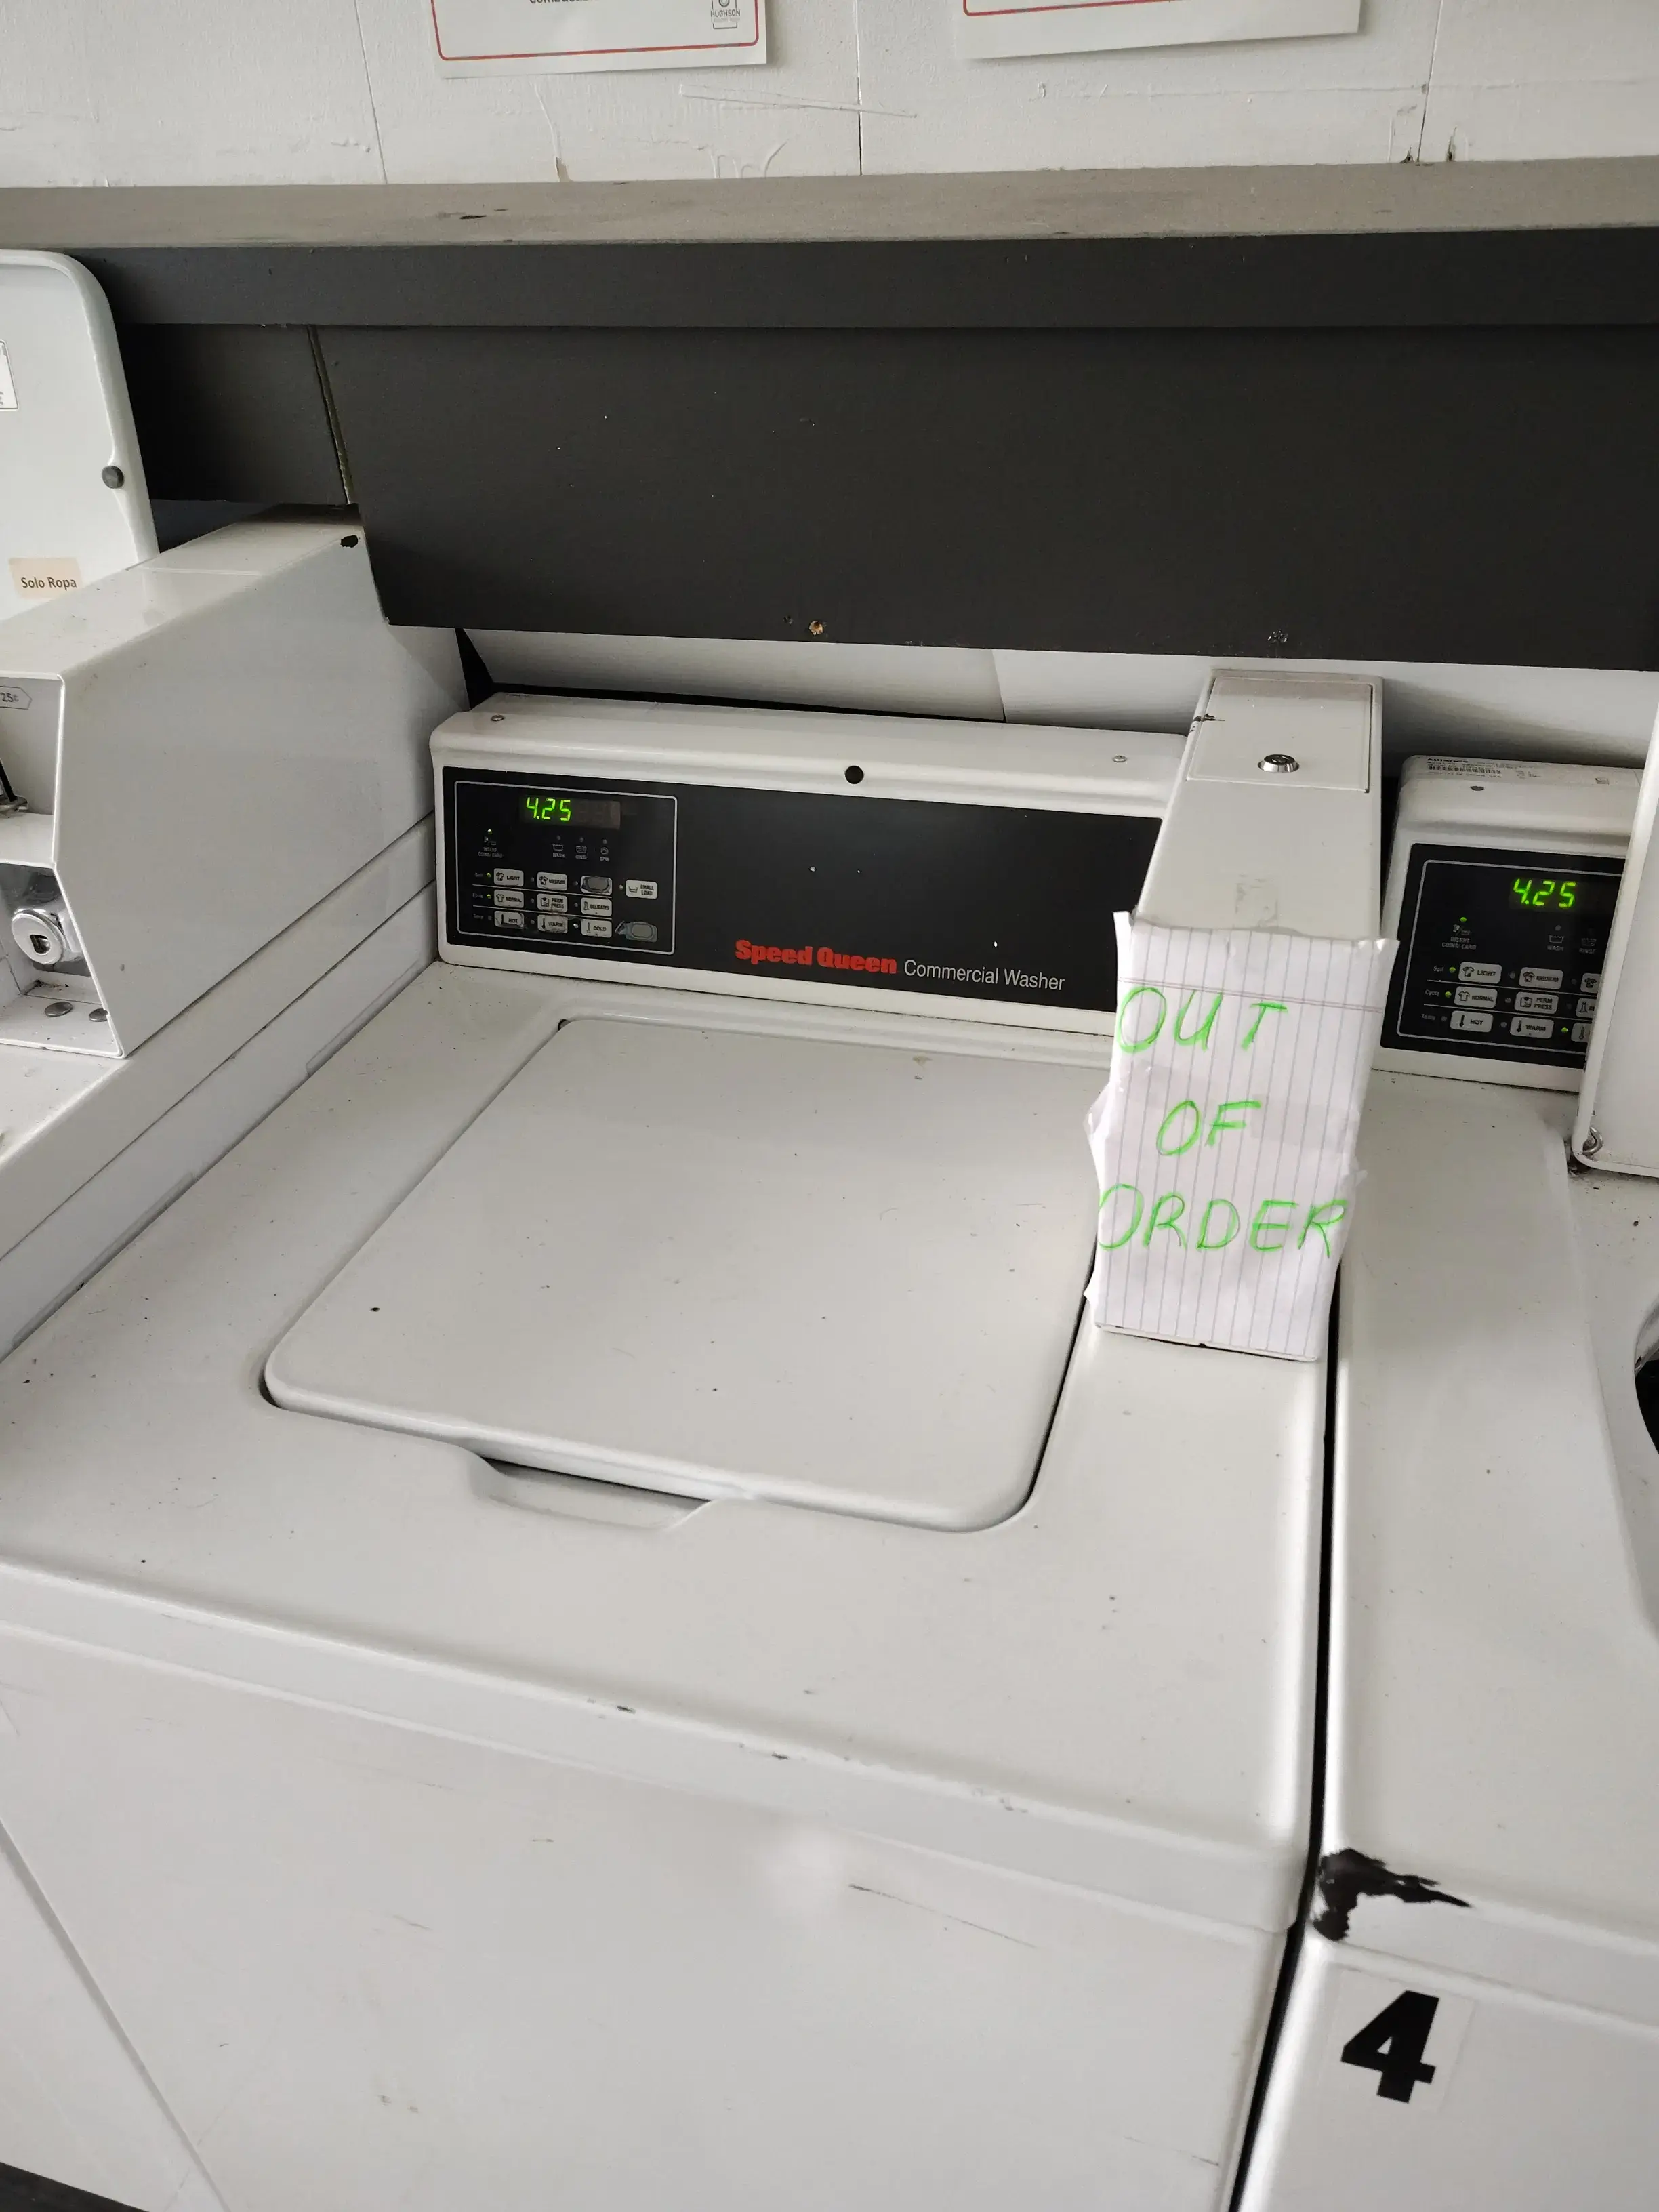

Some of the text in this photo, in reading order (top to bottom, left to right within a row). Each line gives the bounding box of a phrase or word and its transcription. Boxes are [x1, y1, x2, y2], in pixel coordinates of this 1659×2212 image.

[710, 9, 741, 18] HUGHSON
[20, 576, 77, 591] Solo Ropa
[526, 796, 571, 821] 4.25
[1513, 878, 1577, 908] 4.25
[735, 939, 1065, 991] Speed Queen Commercial Washer
[1536, 975, 1559, 983] MEDIUM
[1425, 989, 1440, 997] Cycle
[1471, 994, 1494, 1003] NORMAL
[1115, 987, 1288, 1053] OUT
[1155, 1099, 1263, 1156] OF
[1098, 1183, 1349, 1259] ORDER
[1340, 1989, 1441, 2104] 4
